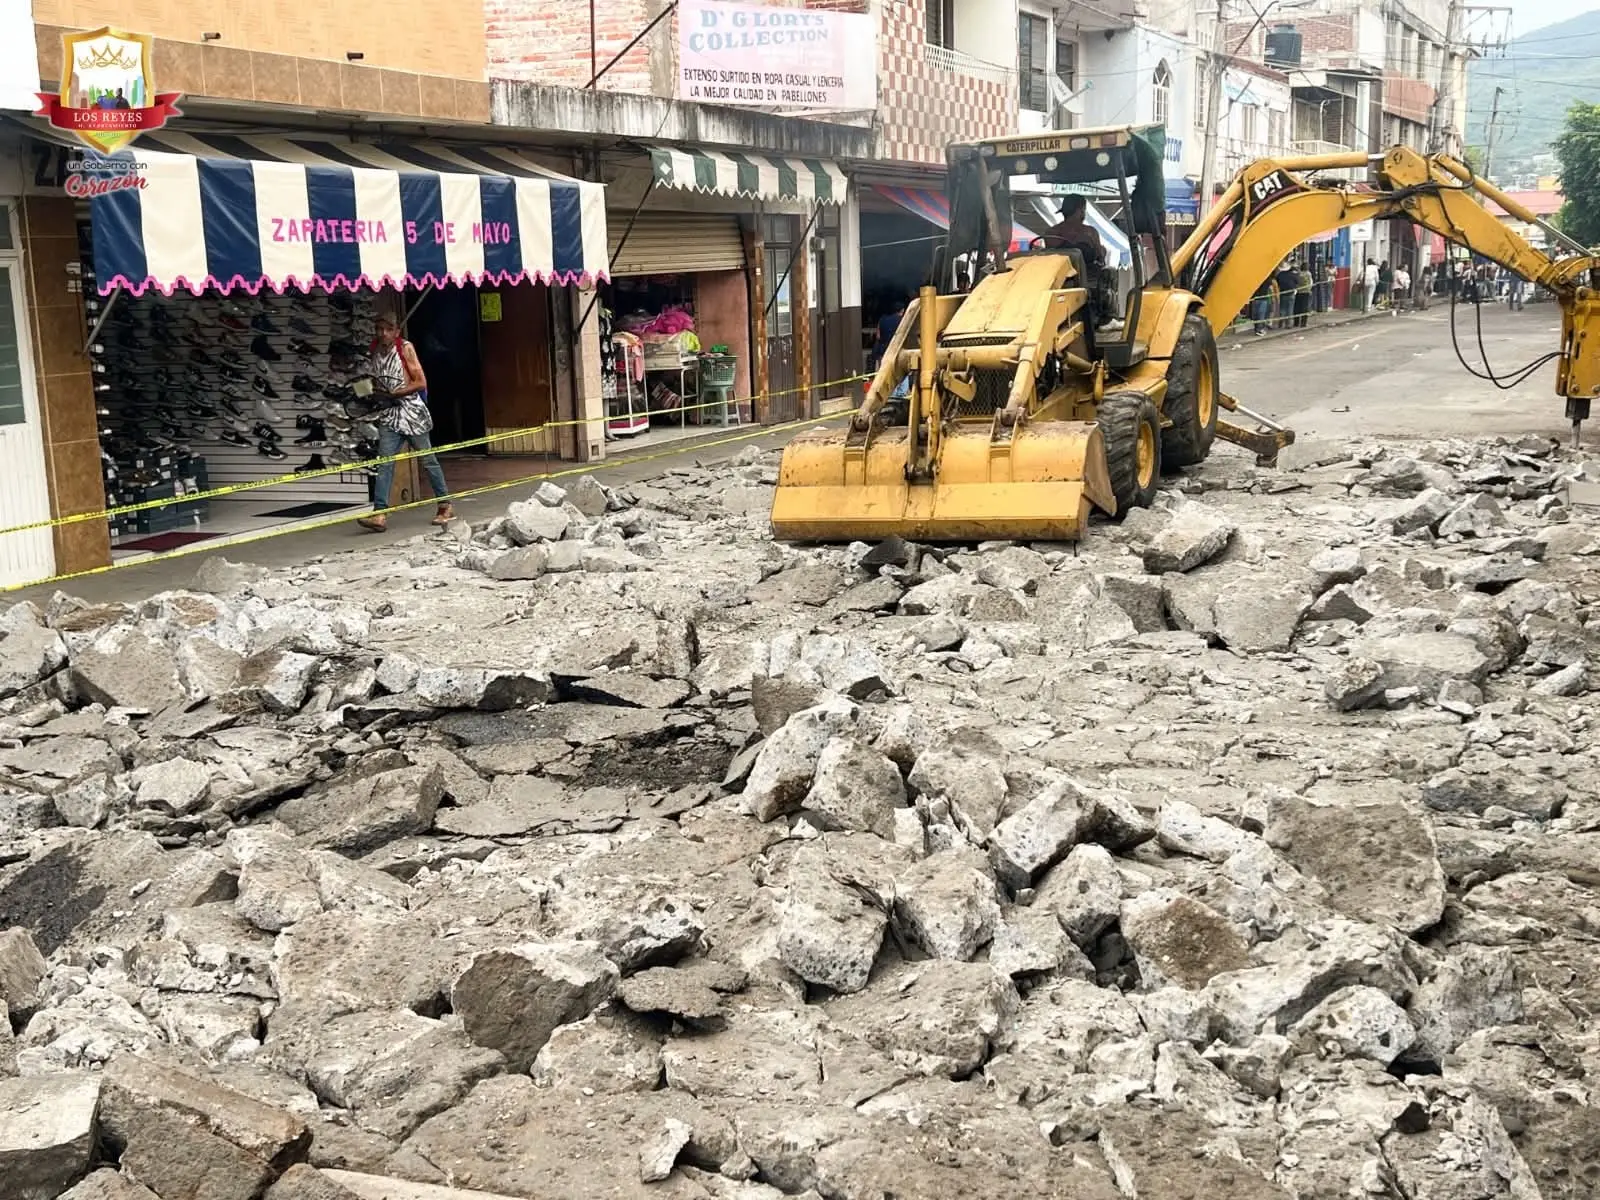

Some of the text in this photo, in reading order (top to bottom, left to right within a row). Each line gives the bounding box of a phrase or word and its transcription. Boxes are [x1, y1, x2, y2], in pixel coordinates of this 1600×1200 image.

[689, 29, 828, 51] COLLECTION
[684, 68, 718, 82] EXTENSO
[720, 71, 750, 84] SURTIDO
[752, 72, 762, 85] EN
[765, 73, 783, 86] ROPA
[785, 73, 811, 88] CASUAL
[812, 75, 817, 87] Y
[690, 86, 827, 103] LA MEJOR CALIDAD EN PABELLONES
[1006, 139, 1061, 153] CATERPILLAR
[1254, 172, 1283, 200] CAT
[271, 218, 511, 244] ZAPATERIA 5 DE MAYO
